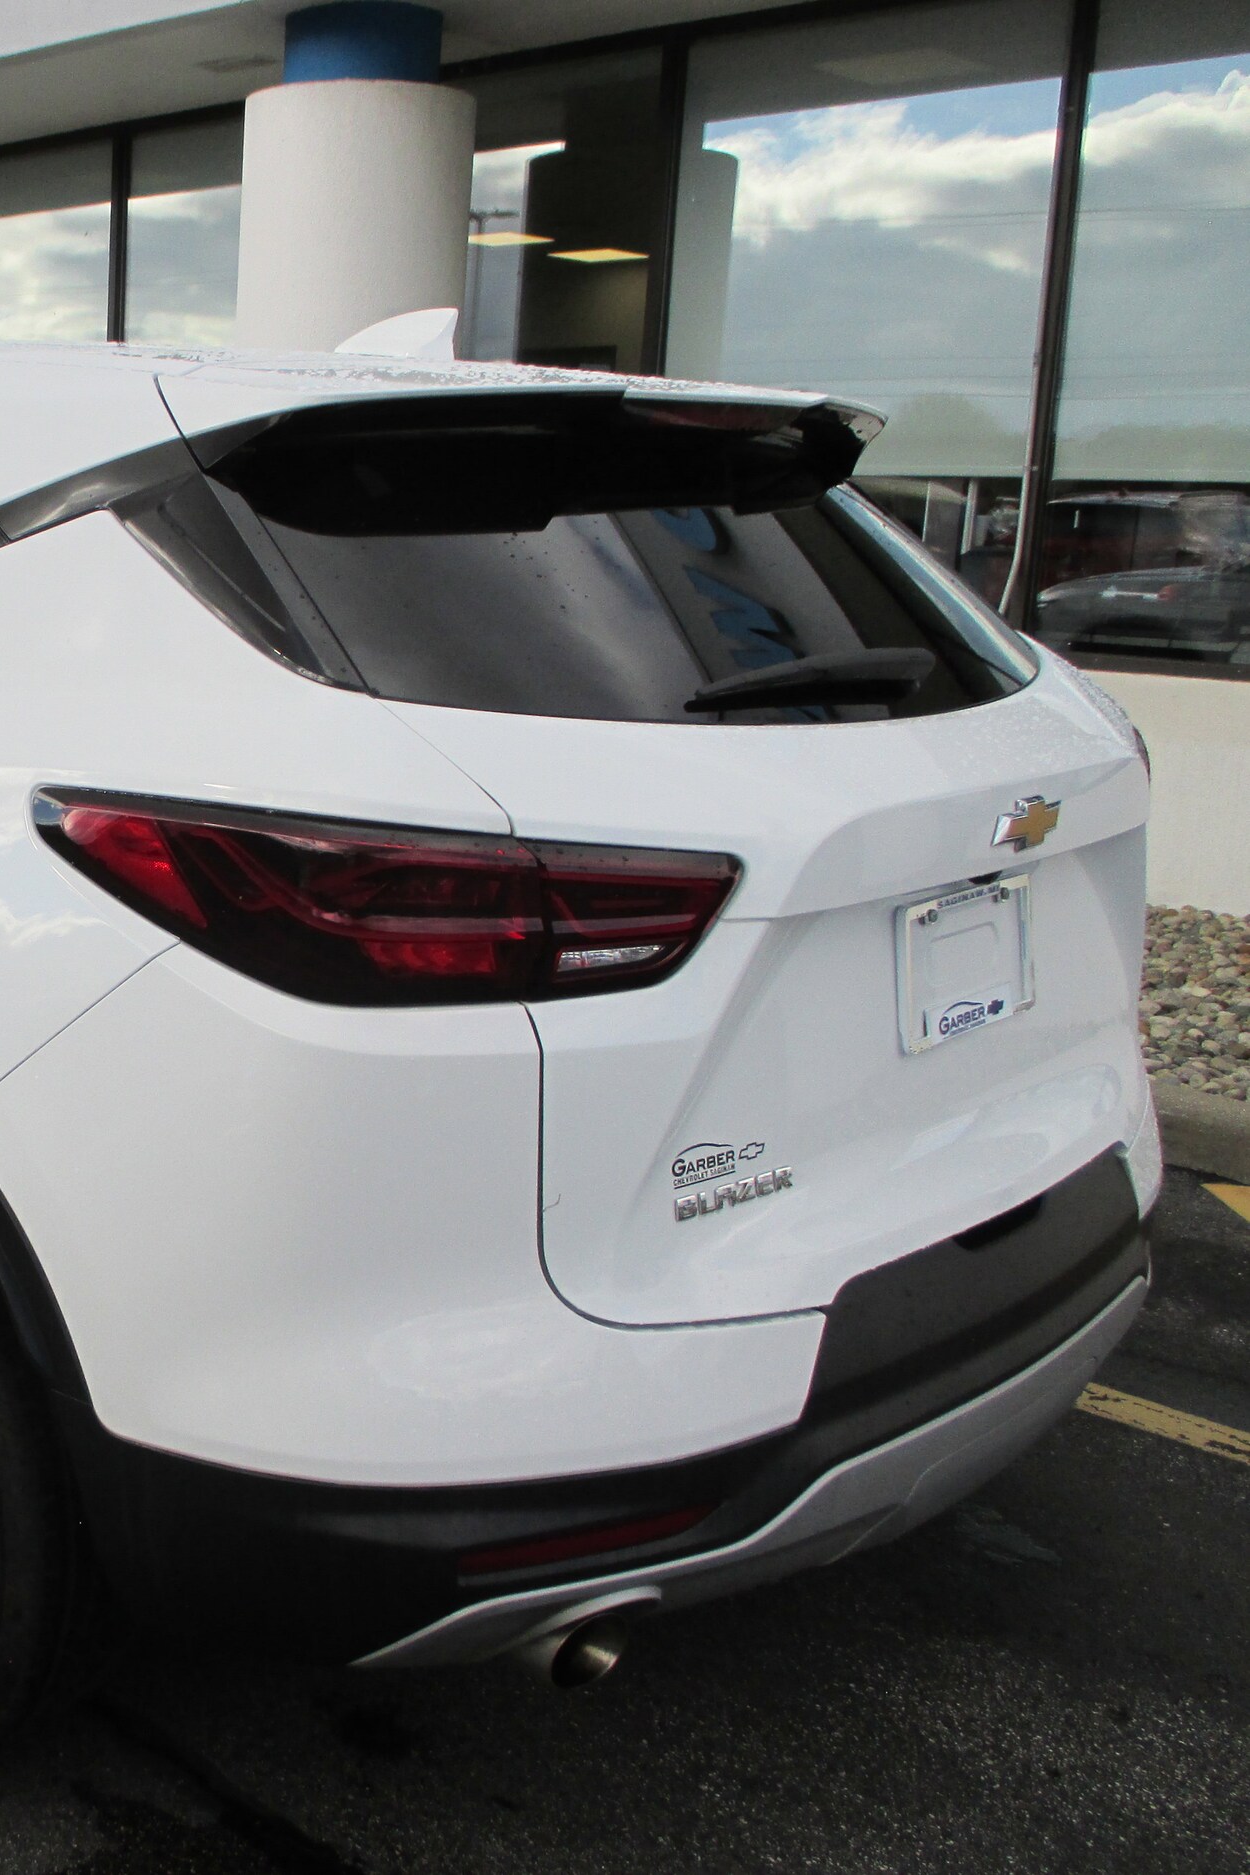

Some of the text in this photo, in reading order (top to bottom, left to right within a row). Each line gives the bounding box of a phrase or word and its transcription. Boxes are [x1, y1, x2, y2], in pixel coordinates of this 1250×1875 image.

[939, 1006, 986, 1035] GARBER
[672, 1150, 735, 1177] GARBER
[673, 1163, 735, 1187] CHEVROLET SAGINAW
[674, 1165, 793, 1223] BLAZER
